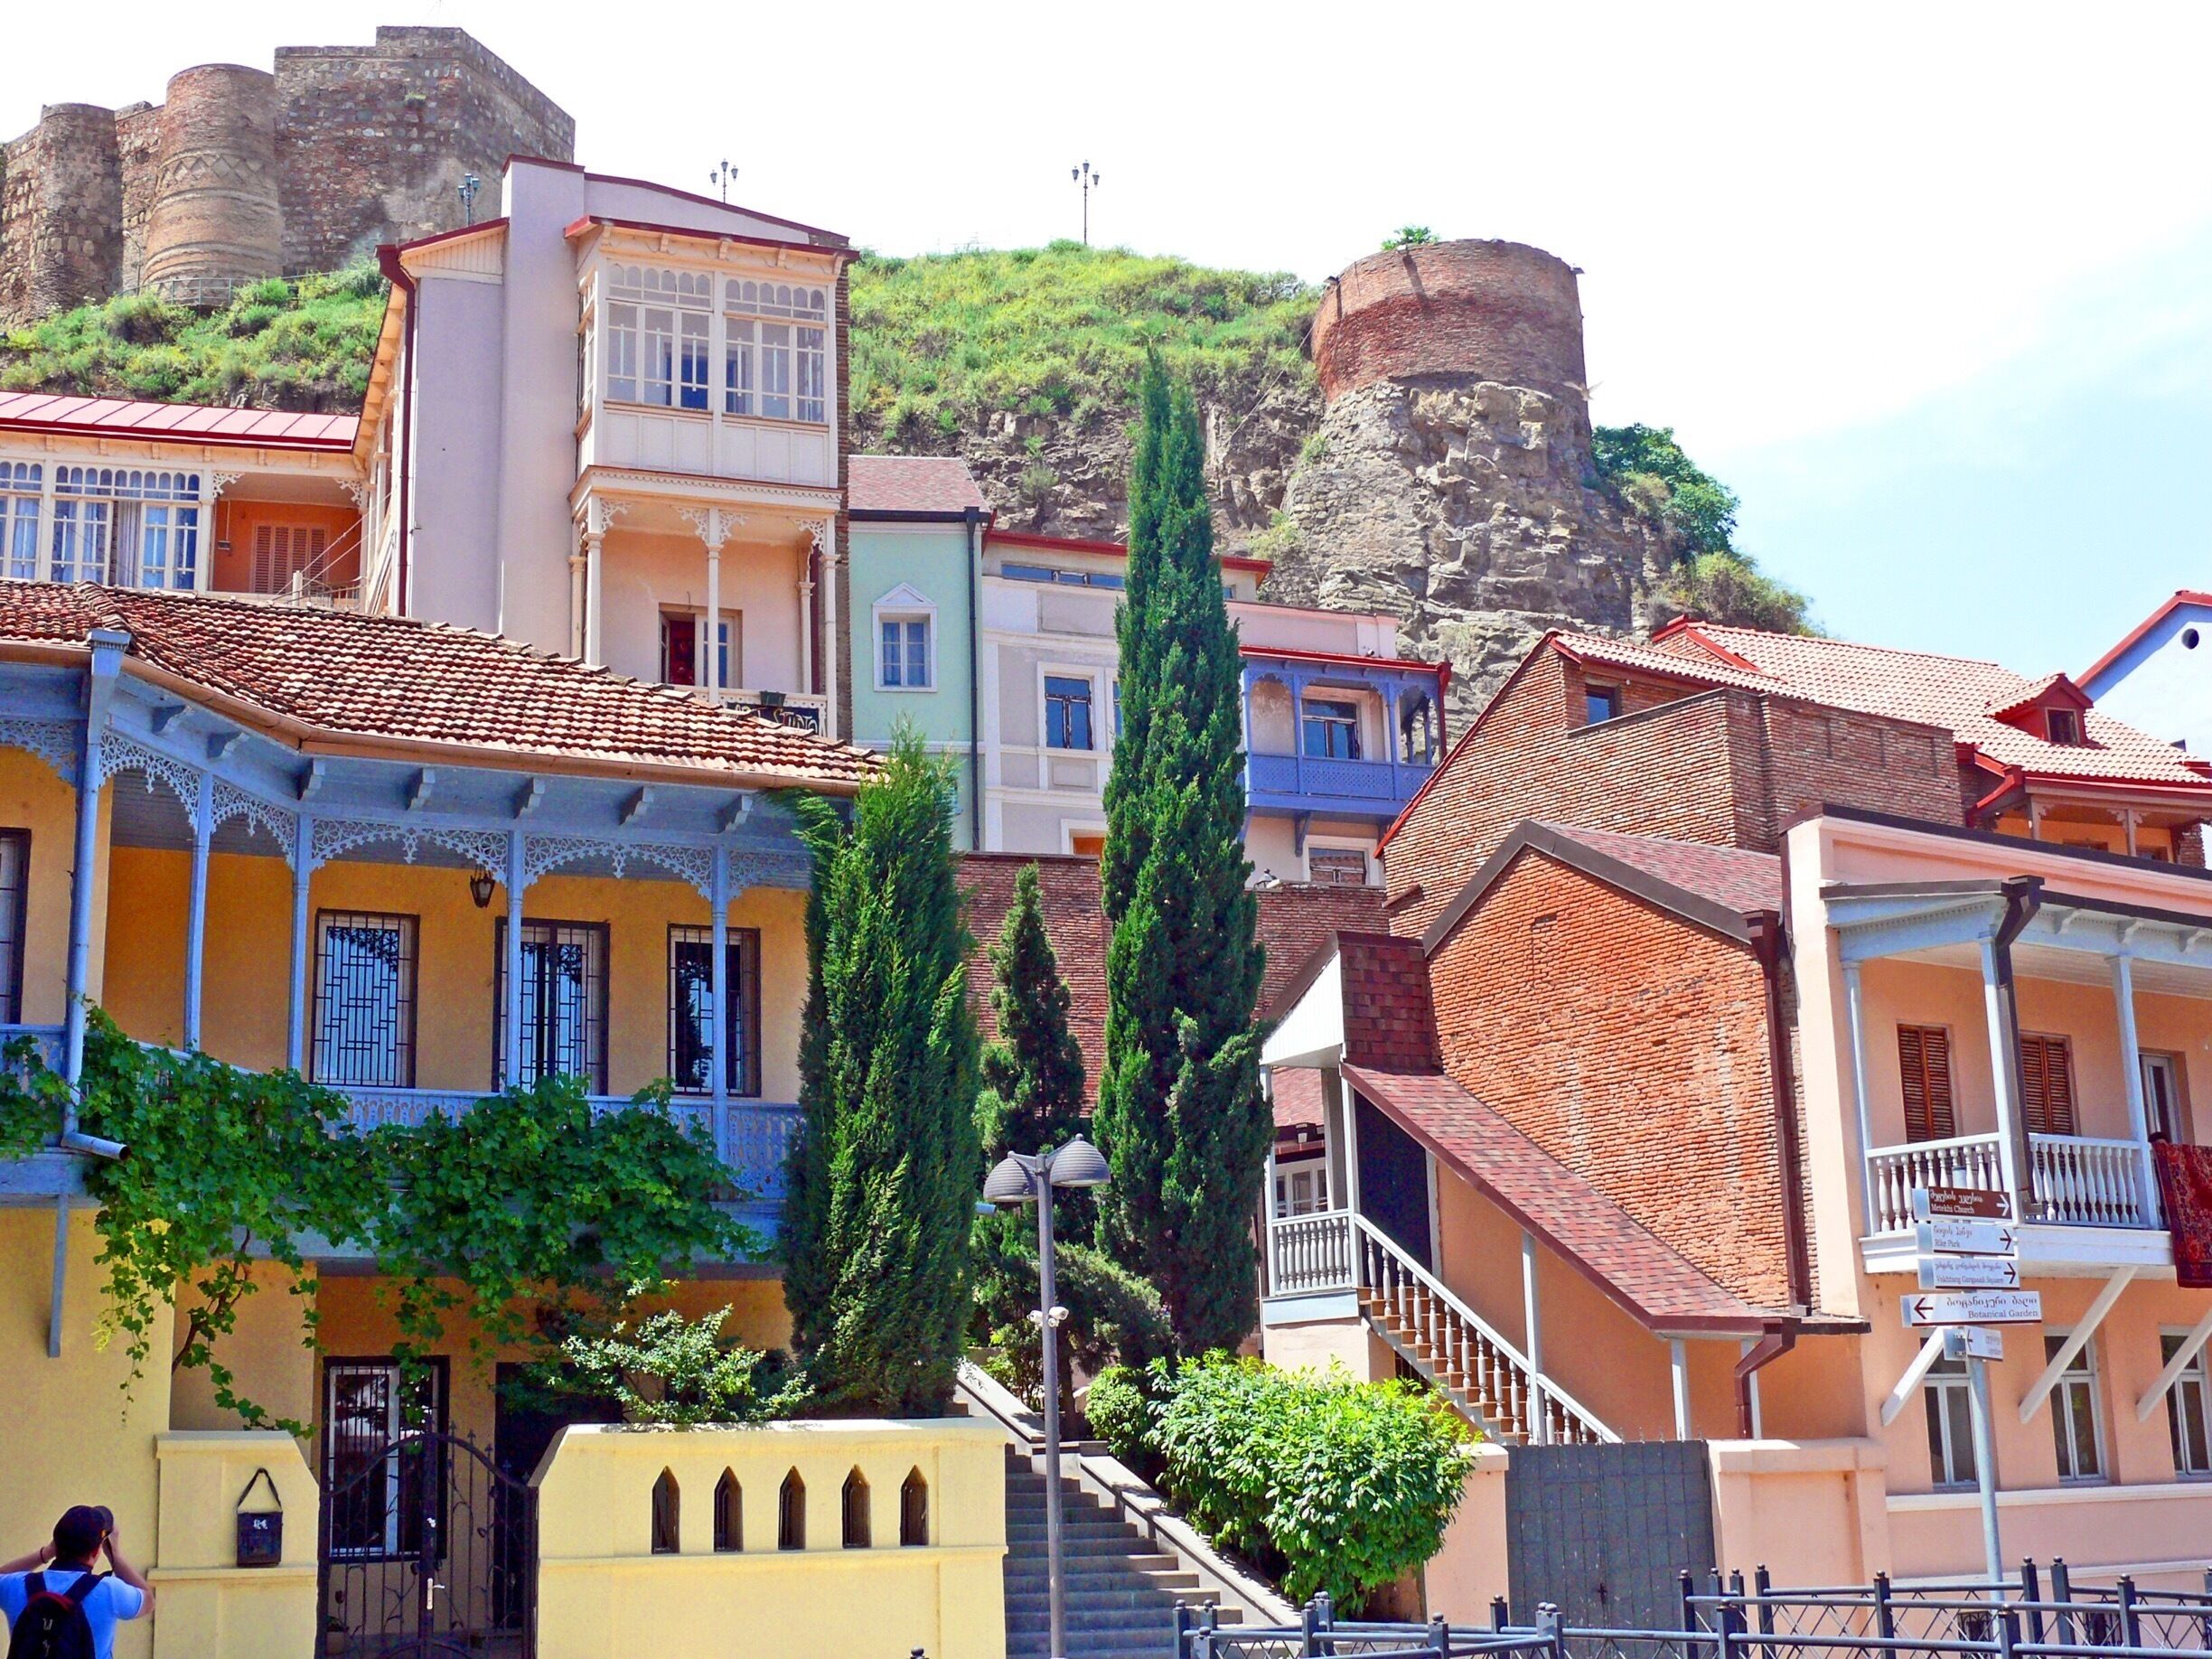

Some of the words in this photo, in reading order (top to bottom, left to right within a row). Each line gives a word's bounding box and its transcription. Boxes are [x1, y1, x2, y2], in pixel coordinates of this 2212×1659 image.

[1954, 1204, 1974, 1214] Church
[1947, 1240, 1961, 1248] Park
[1946, 1295, 2006, 1308] ბოტანიკური
[2011, 1295, 2037, 1307] ბაღი
[1968, 1309, 2006, 1318] Botanical
[2009, 1309, 2039, 1317] Garden
